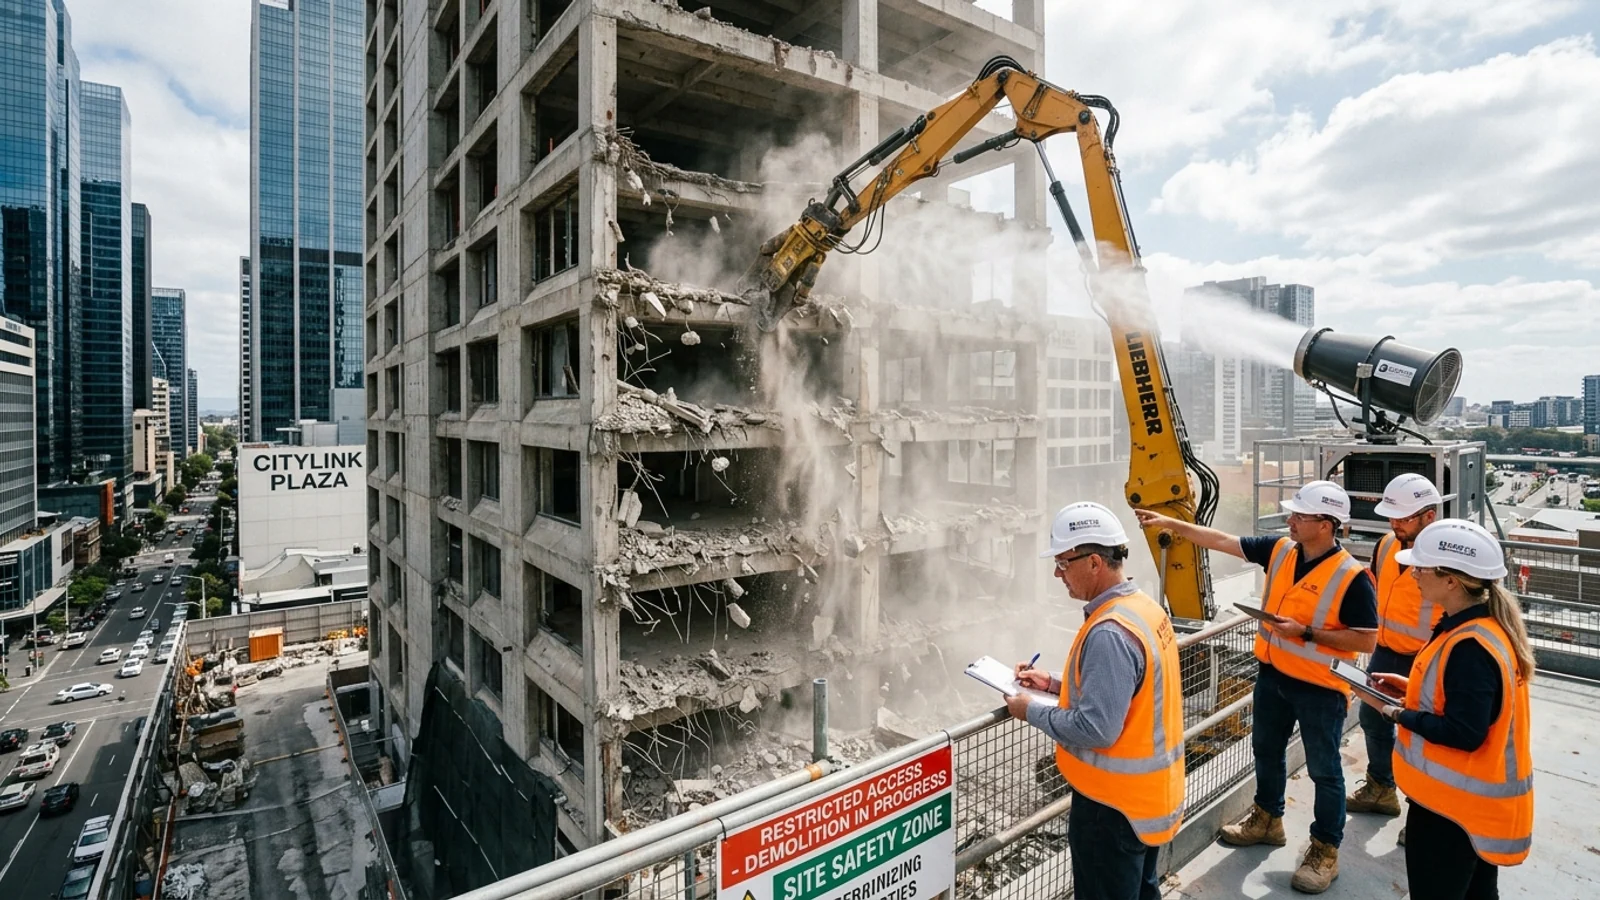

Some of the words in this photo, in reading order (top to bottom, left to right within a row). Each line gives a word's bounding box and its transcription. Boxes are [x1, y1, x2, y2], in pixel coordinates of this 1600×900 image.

[1126, 332, 1163, 436] LIEBHERR
[253, 451, 363, 472] CITYLINK
[271, 471, 349, 492] PLAZA
[745, 816, 850, 874] DEMOLITION
[855, 805, 870, 826] IN
[874, 770, 947, 818] PROGRESS
[760, 788, 863, 846] RESTRICTED
[866, 762, 923, 801] ACCESS
[783, 861, 827, 900] SITE
[831, 827, 898, 880] SAFETY
[902, 804, 943, 844] ZONE
